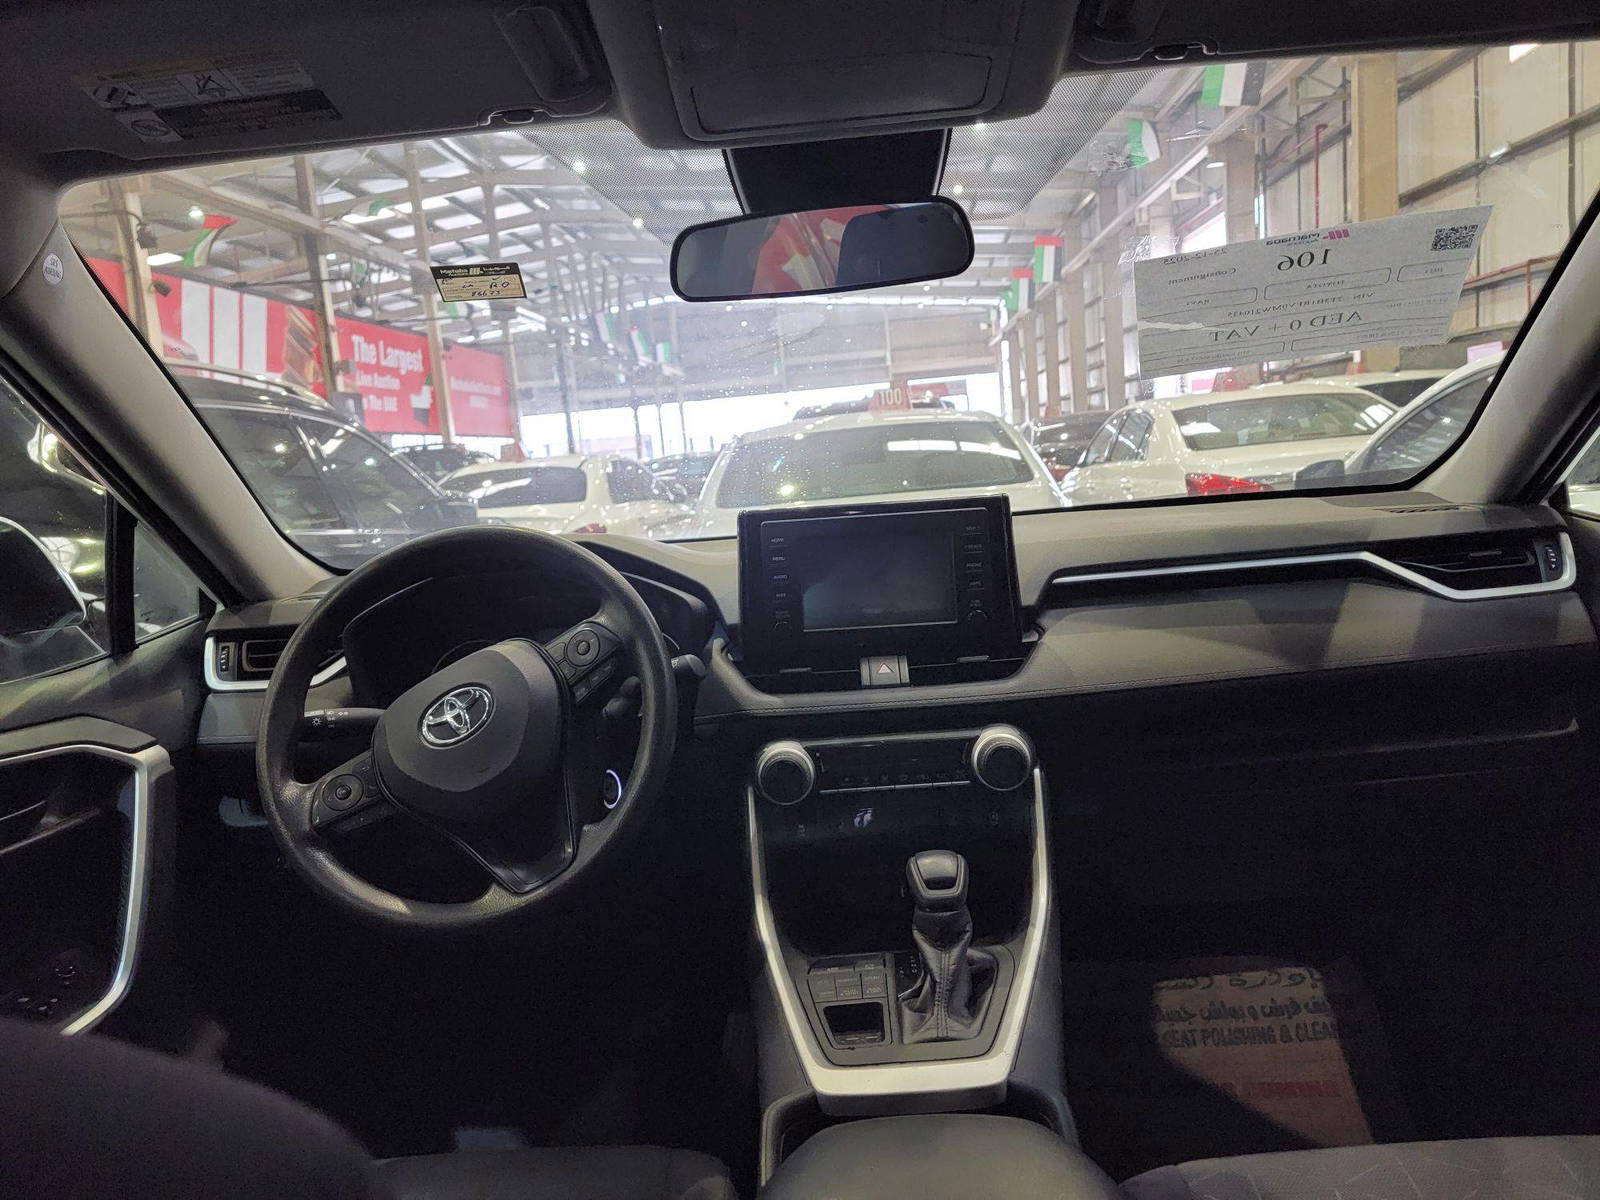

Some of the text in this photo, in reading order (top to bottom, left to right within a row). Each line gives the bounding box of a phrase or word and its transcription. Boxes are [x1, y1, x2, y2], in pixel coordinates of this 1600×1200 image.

[351, 334, 424, 375] The Largest
[880, 388, 902, 405] 100
[1201, 1025, 1277, 1047] POLISHING
